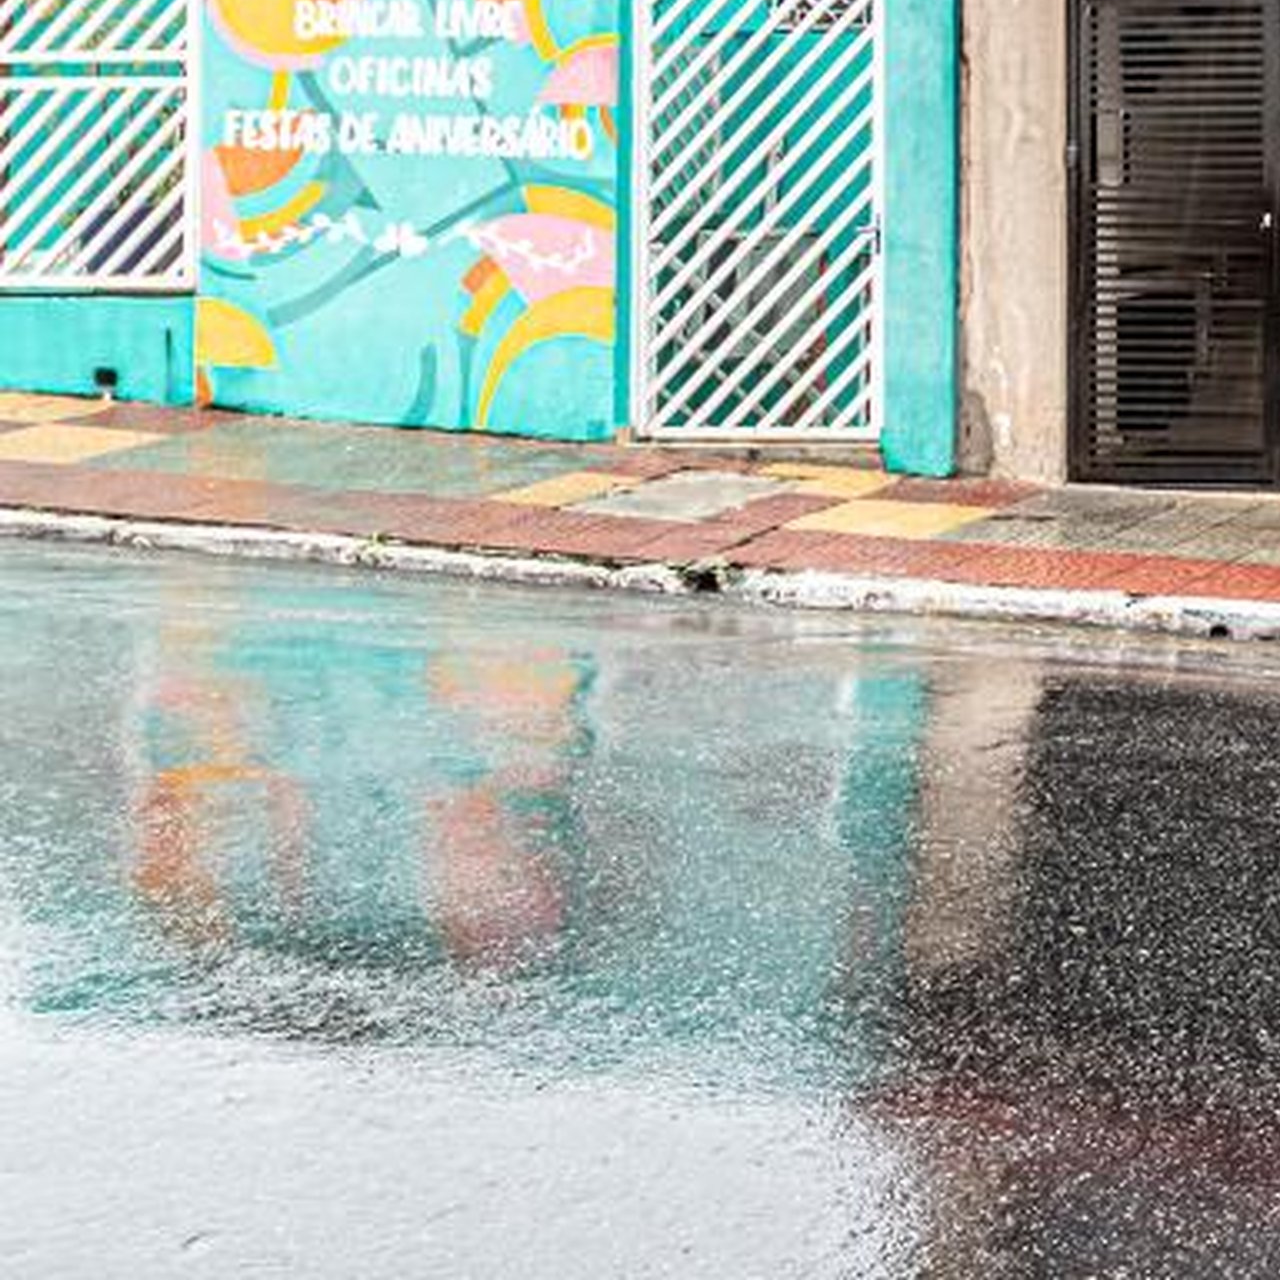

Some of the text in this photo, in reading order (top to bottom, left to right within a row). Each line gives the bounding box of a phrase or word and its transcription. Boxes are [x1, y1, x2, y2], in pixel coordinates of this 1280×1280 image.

[328, 55, 494, 98] OFICINAS
[224, 104, 594, 160] FESTAS DE ANIVERSÁRIO
